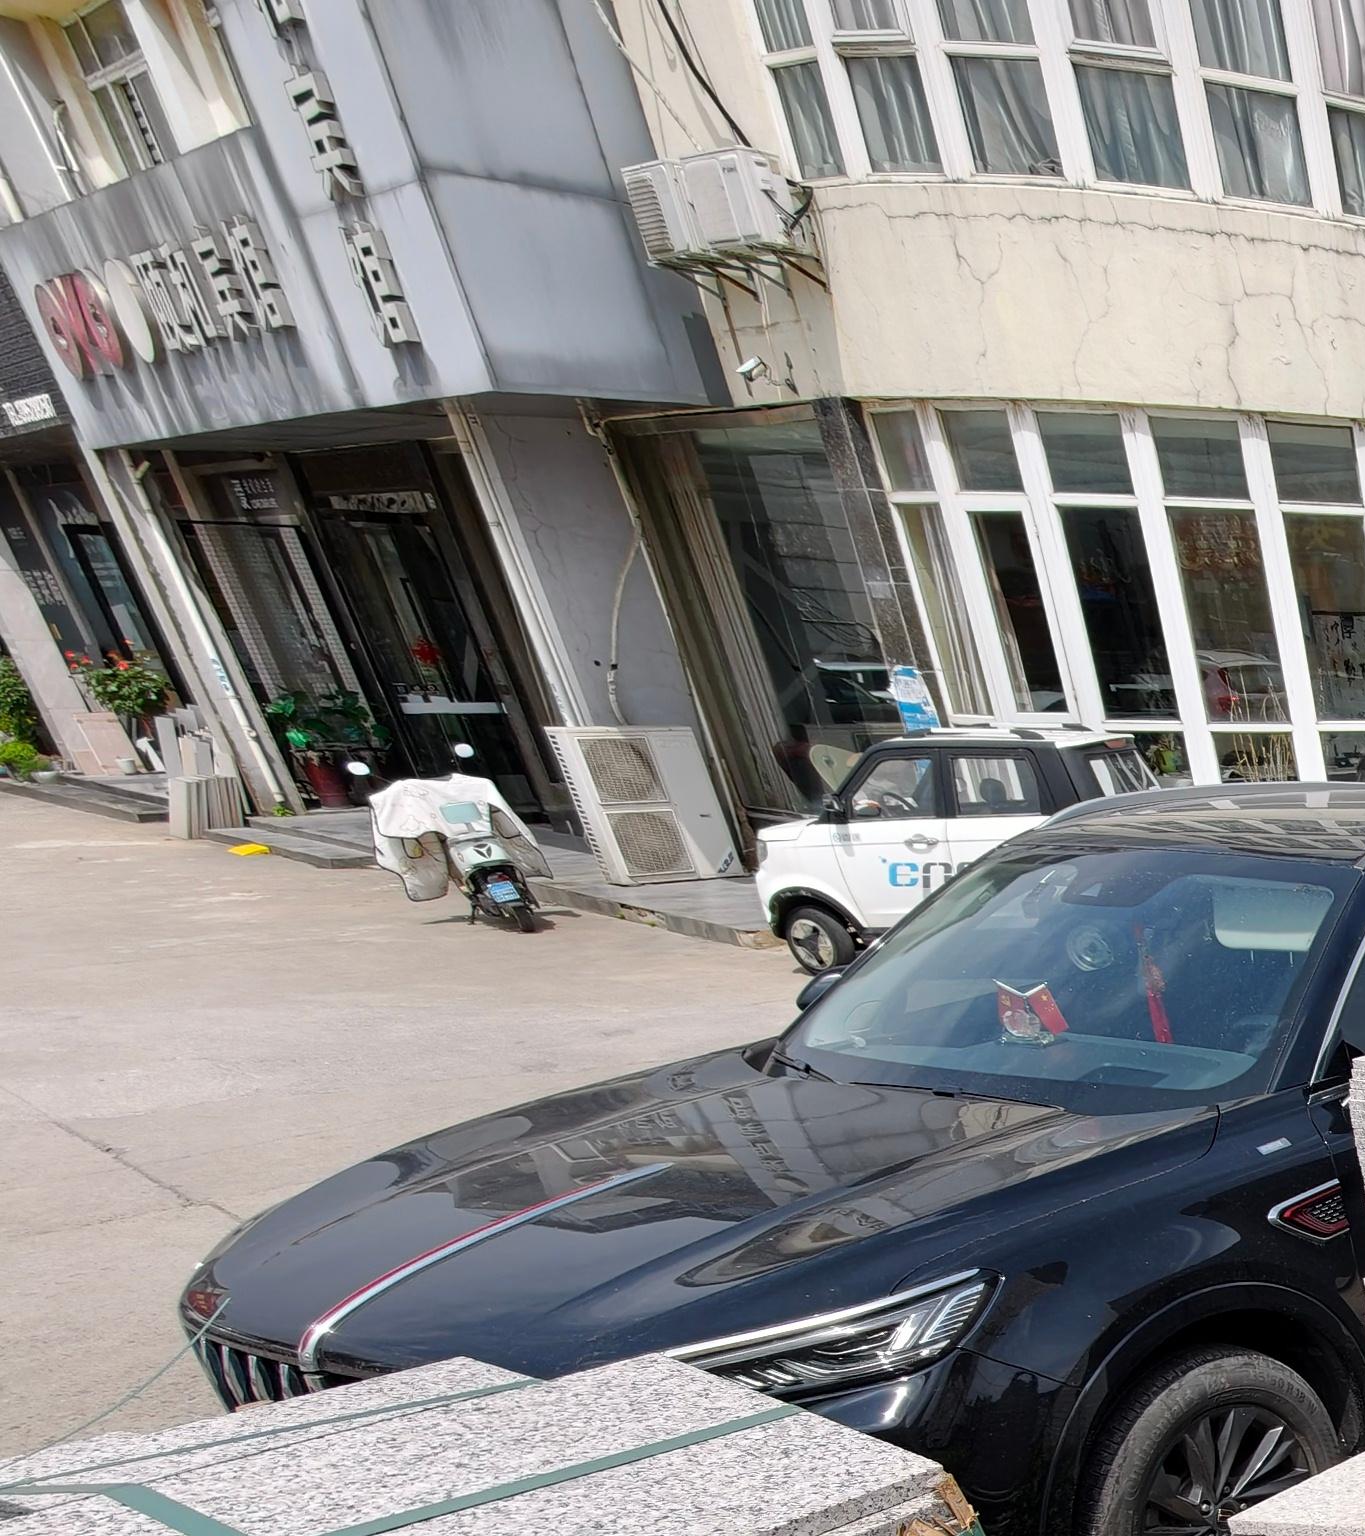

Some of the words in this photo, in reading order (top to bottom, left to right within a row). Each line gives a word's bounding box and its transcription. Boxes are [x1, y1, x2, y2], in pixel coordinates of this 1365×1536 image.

[130, 216, 292, 354] 颐和宾馆
[260, 0, 420, 348] 宾馆
